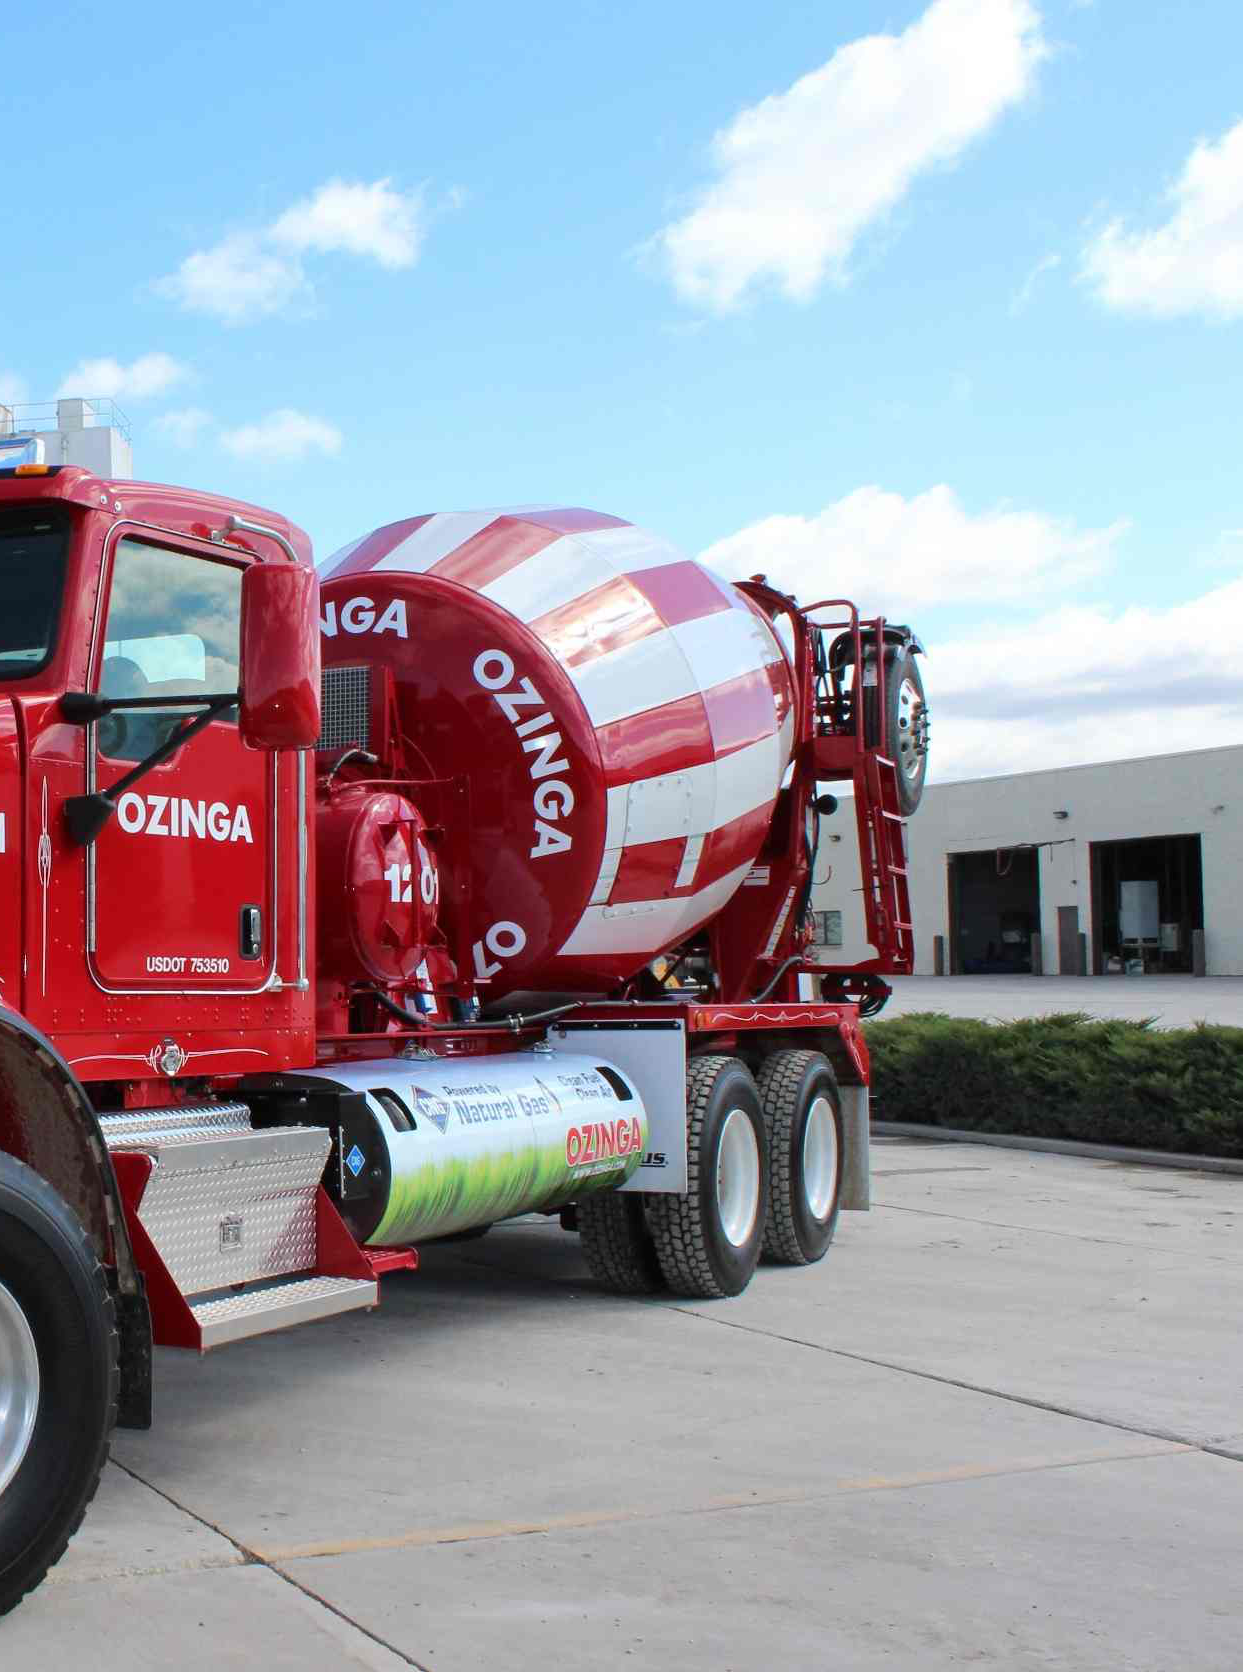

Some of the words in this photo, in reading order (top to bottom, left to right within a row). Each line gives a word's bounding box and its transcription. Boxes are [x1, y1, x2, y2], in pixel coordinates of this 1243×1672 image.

[473, 649, 574, 859] OZINGA
[117, 792, 254, 845] OZINGA
[146, 957, 187, 972] USDOT
[190, 957, 230, 974] 753510
[453, 1095, 517, 1125] Natural
[519, 1094, 549, 1117] Gas
[566, 1117, 642, 1167] OZINGA
